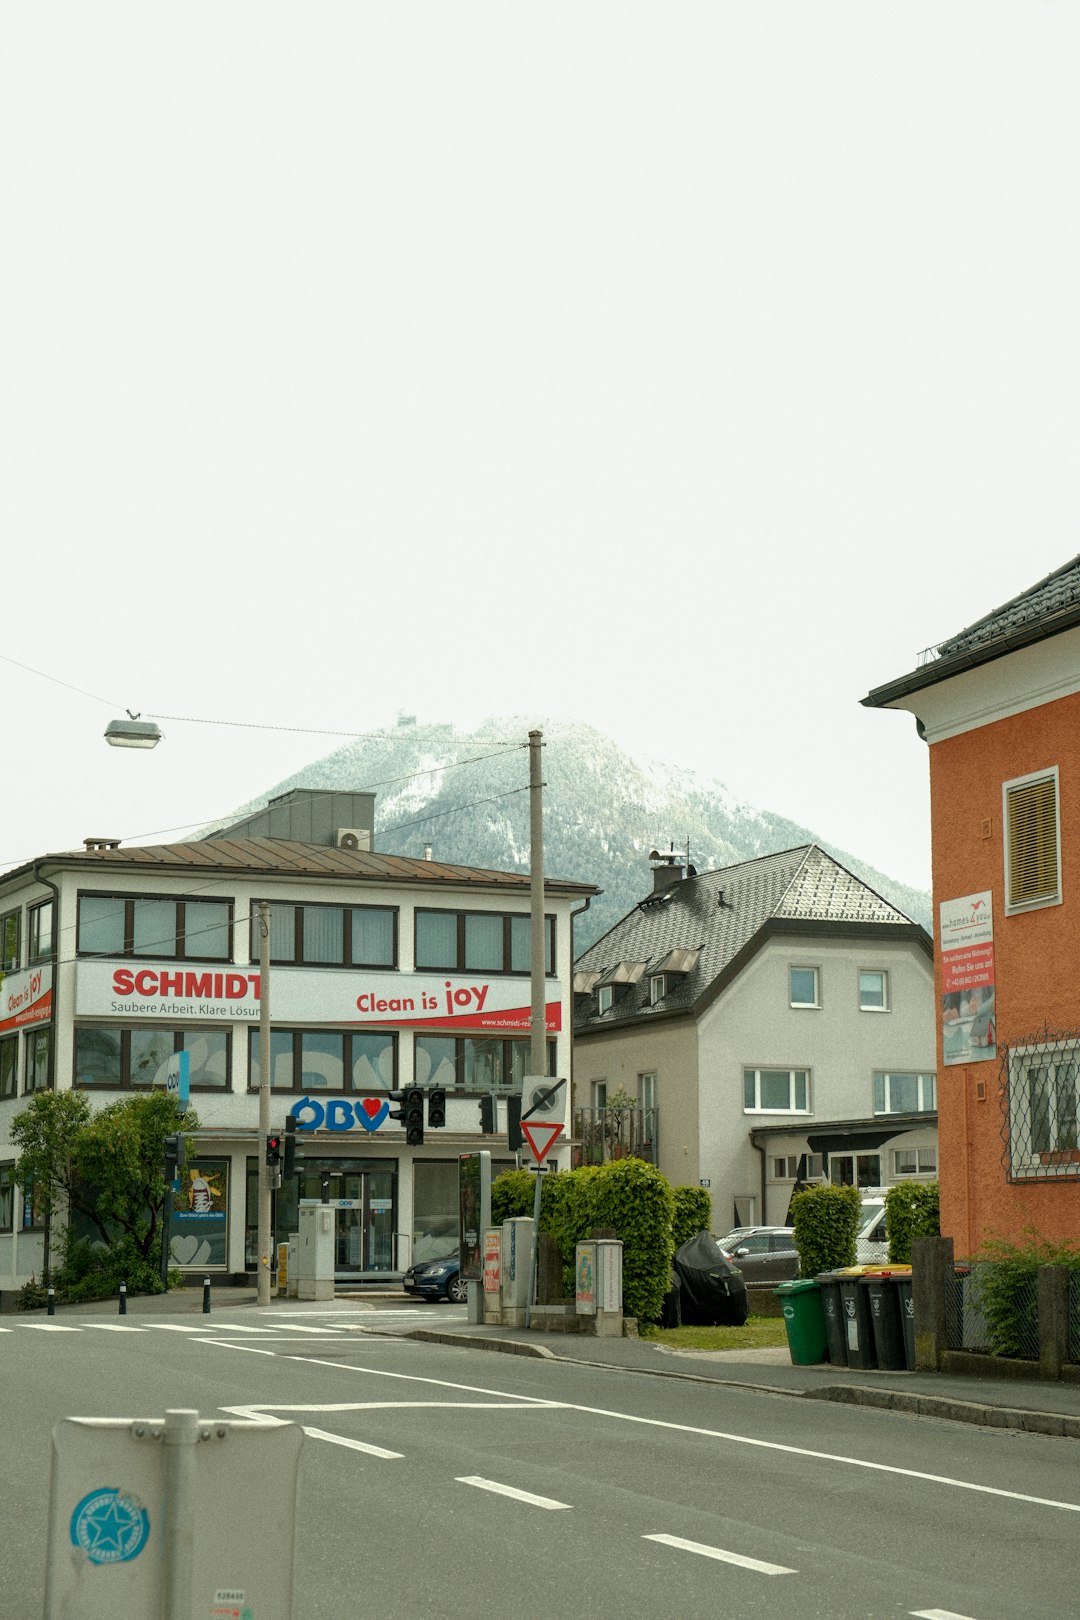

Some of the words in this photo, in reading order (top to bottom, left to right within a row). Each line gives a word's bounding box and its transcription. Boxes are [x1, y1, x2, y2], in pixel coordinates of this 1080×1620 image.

[952, 964, 966, 974] Rufen
[966, 962, 974, 972] Sie
[975, 961, 984, 970] uns
[984, 958, 993, 968] an!
[971, 946, 993, 958] Wohnung?
[8, 994, 23, 1011] Clean
[24, 985, 29, 1001] is
[29, 969, 42, 1003] joy
[113, 969, 260, 1000] SCHMIDT
[356, 993, 415, 1012] Clean
[421, 991, 438, 1010] is
[444, 981, 490, 1015] joy
[111, 1001, 157, 1013] Saubere
[159, 1003, 197, 1015] Arbeit.
[199, 1004, 227, 1016] Klare
[290, 1096, 390, 1132] ÖBV
